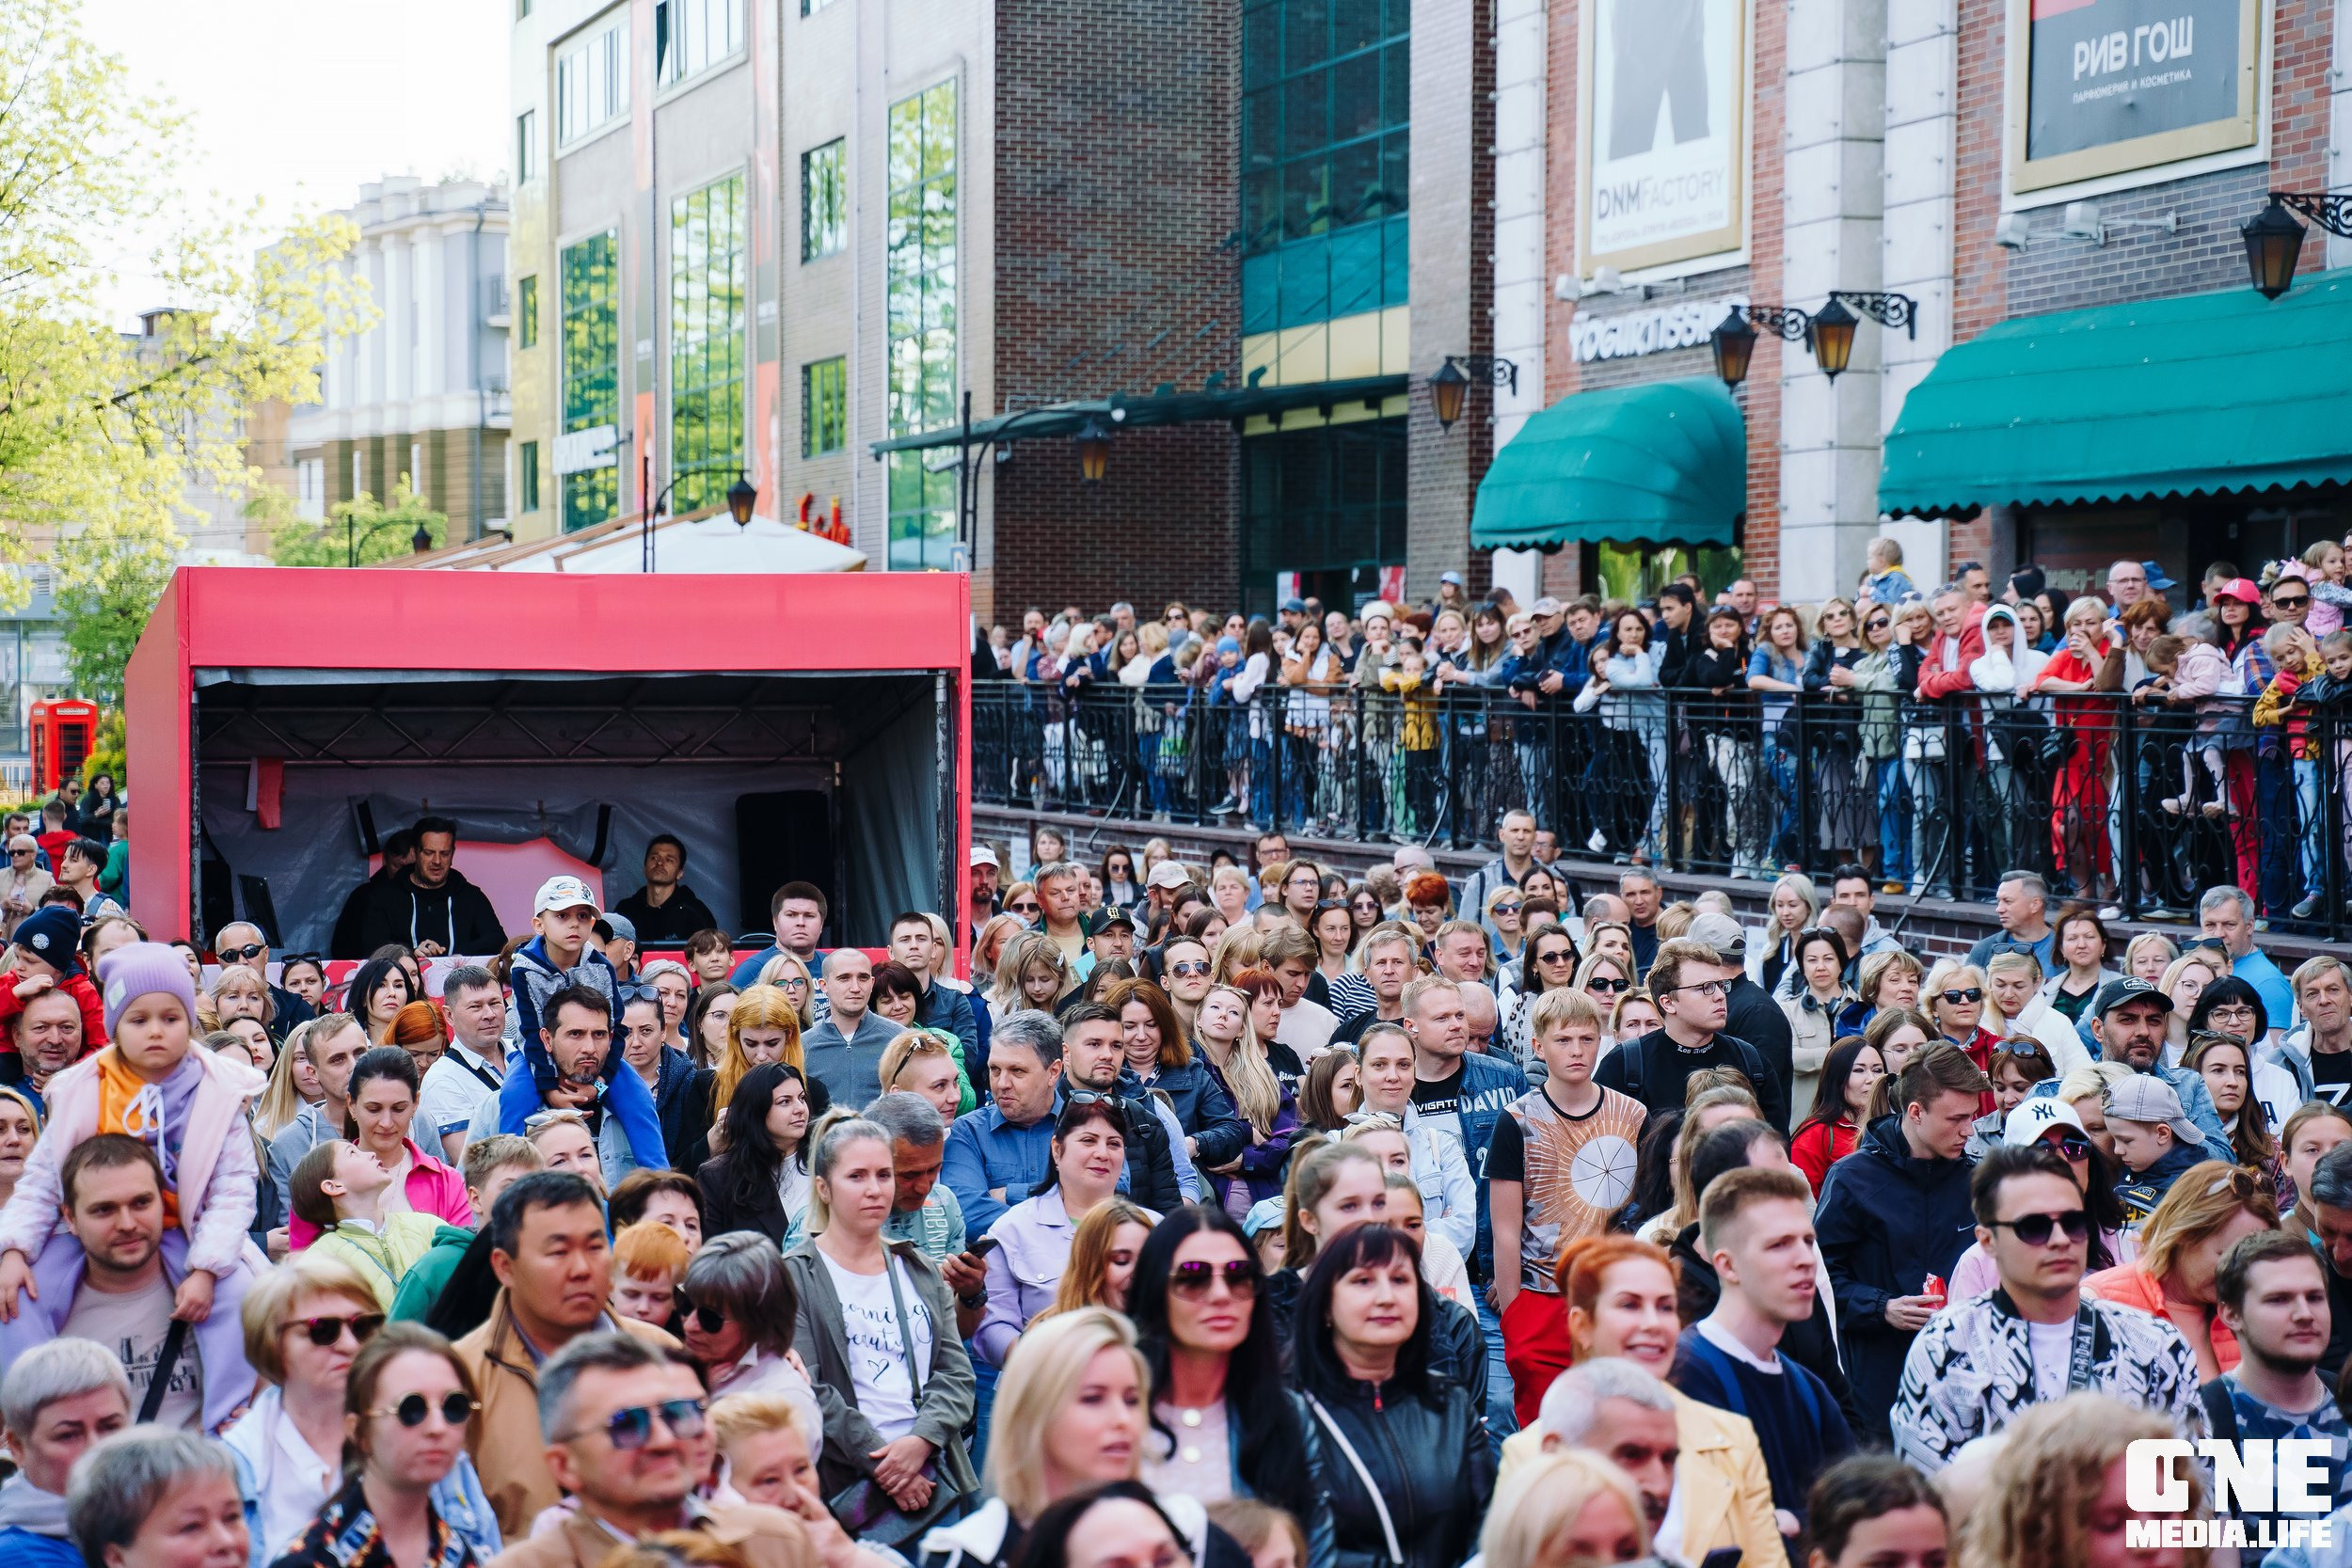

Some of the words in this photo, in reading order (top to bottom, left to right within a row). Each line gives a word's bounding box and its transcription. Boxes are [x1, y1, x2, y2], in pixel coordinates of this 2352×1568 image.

[2073, 30, 2129, 82] РИВ
[2133, 14, 2194, 67] ГОШ
[2073, 79, 2129, 104] ПАРФЮМЕРИЯ
[2131, 78, 2138, 90] И
[2139, 68, 2193, 89] КОСМЕТИКА
[1460, 1085, 1518, 1115] DAVID
[2031, 1102, 2057, 1121] NY
